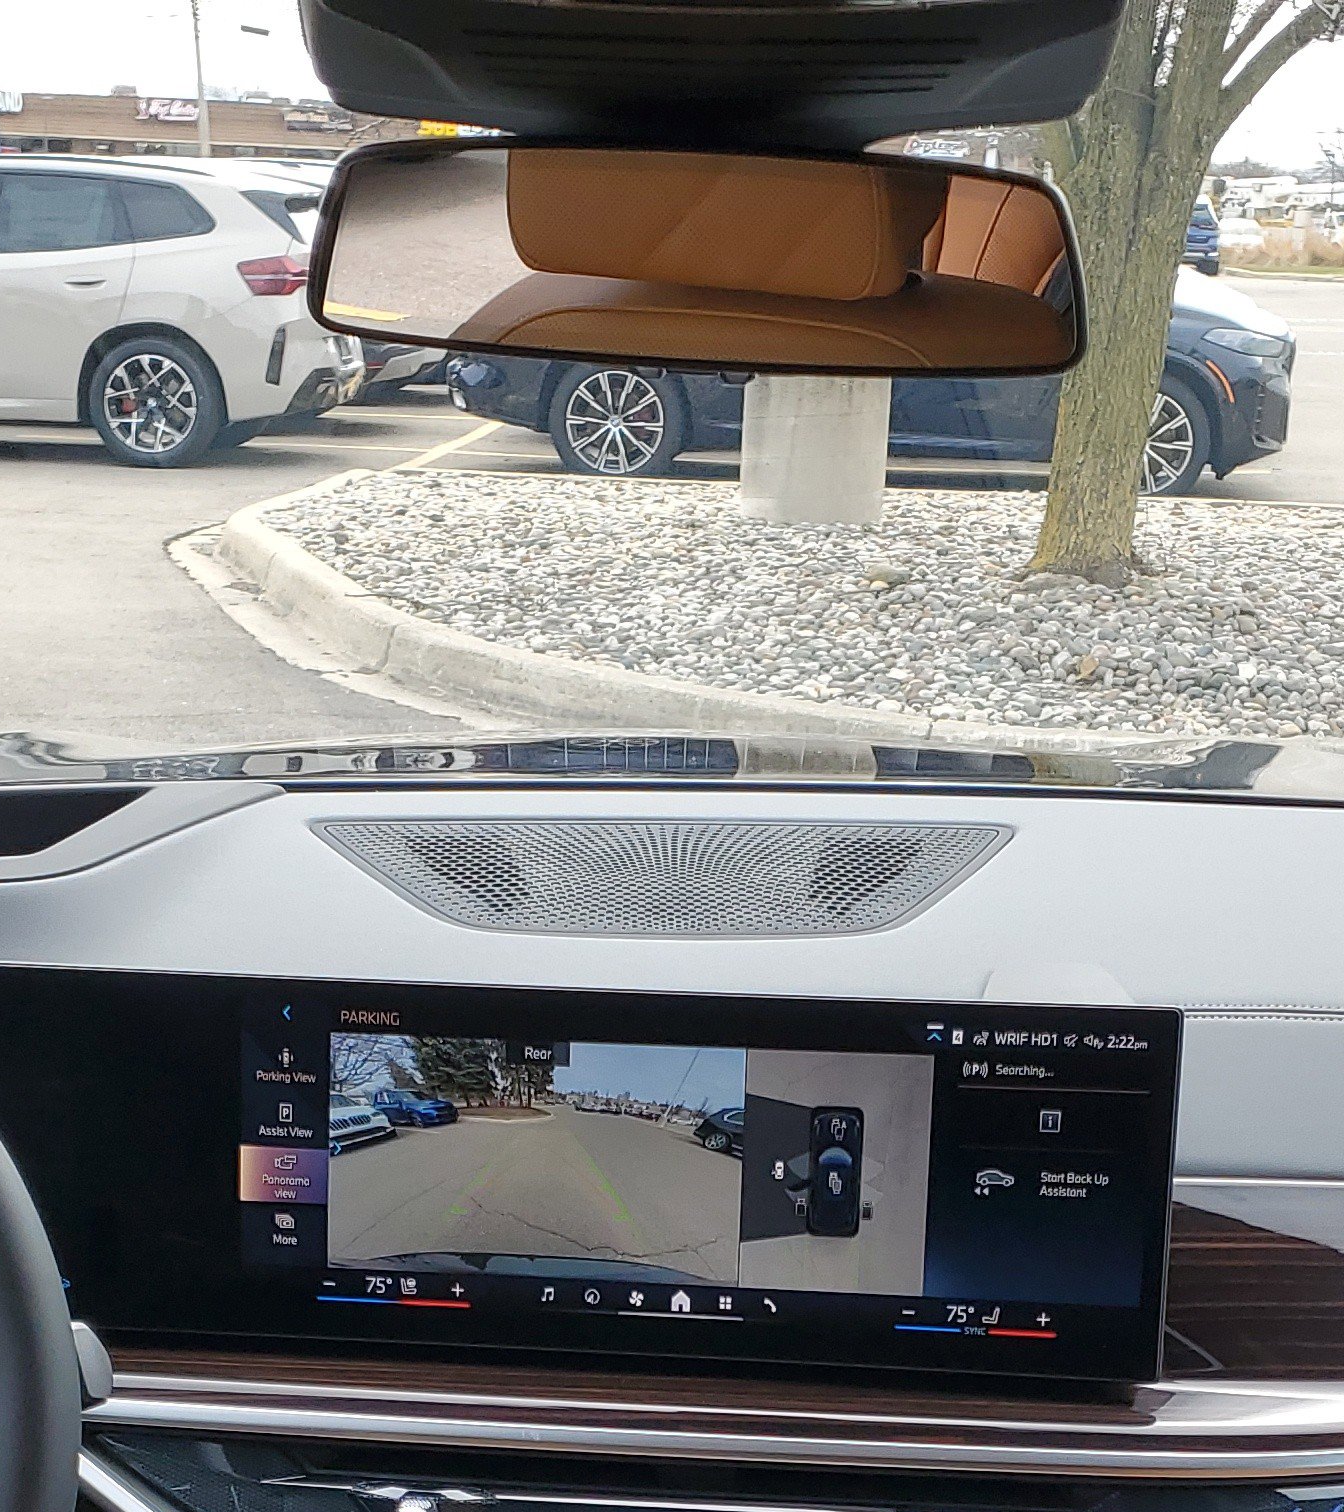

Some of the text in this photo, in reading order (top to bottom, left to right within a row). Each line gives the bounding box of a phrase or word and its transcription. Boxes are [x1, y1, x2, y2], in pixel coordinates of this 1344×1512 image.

[340, 1010, 400, 1026] PARKING
[994, 1032, 1058, 1047] WRIF HD1
[1107, 1035, 1148, 1051] 2:22pm
[524, 1046, 552, 1060] Rear
[256, 1069, 317, 1084] Parking View
[259, 1125, 313, 1138] Assist View
[262, 1174, 310, 1187] Panorama
[1040, 1171, 1109, 1186] Start Back Up
[274, 1189, 296, 1199] view
[1039, 1185, 1087, 1198] Assistant
[273, 1234, 298, 1246] More
[963, 1327, 987, 1336] SYNC
